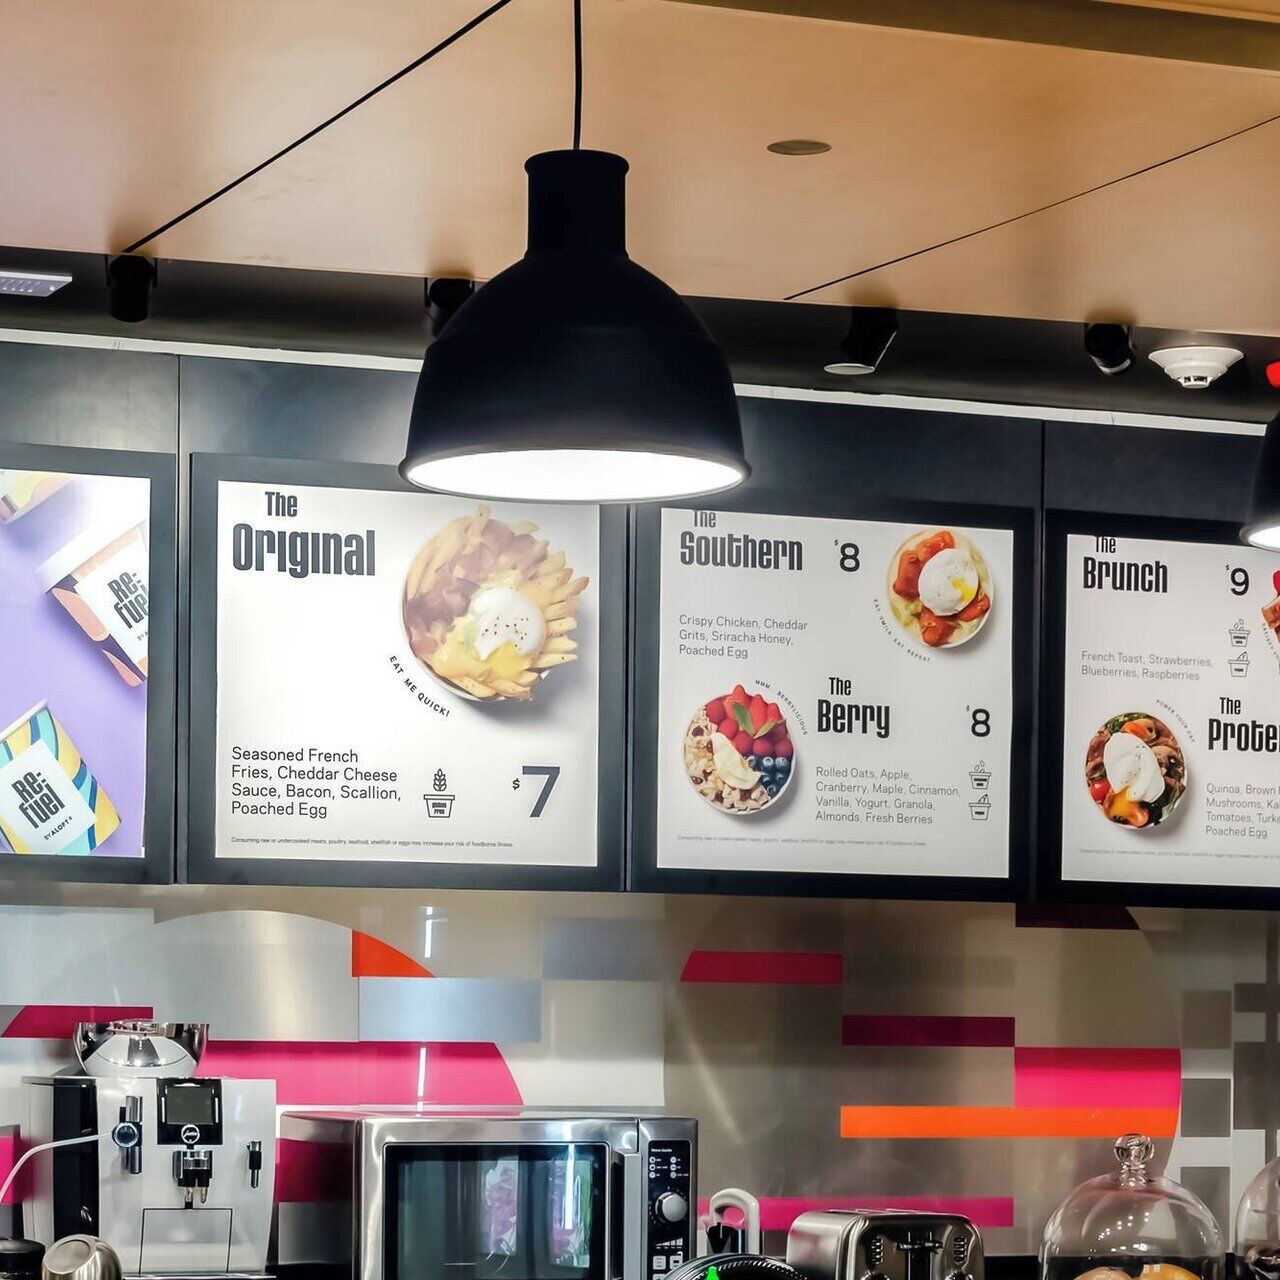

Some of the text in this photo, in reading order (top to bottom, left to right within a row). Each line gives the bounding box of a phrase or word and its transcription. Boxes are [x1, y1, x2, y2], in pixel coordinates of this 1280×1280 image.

[265, 491, 297, 517] The
[233, 523, 375, 578] Original
[681, 531, 802, 571] Southern
[1083, 557, 1167, 593] Brunch
[107, 571, 141, 604] Re:
[679, 614, 808, 630] Crispy Chicken, Cheddar
[679, 629, 793, 646] Grits, Sriracha Honey,
[679, 644, 748, 659] Poached Egg
[1081, 650, 1213, 667] French Toast, Strawberries,
[1081, 664, 1200, 681] Blueberries, Raspberries
[389, 655, 450, 717] EAT ME QUICK!
[829, 677, 851, 695] The
[1220, 697, 1241, 715] The
[818, 699, 890, 738] Berry
[232, 746, 358, 762] Seasoned French
[232, 765, 397, 782] Fries, Cheddar Cheese
[816, 766, 912, 781] Rolled Oats, Apple,
[11, 771, 47, 803] Re:
[232, 783, 401, 801] Sauce, Bacon, Scallion,
[816, 781, 869, 795] Cranberry,
[909, 784, 961, 798] Cinnamon,
[1207, 783, 1242, 797] Quinoa,
[1246, 784, 1276, 795] Brown
[19, 782, 65, 829] fuel
[232, 801, 327, 819] Poached Egg
[894, 798, 935, 812] Granola,
[1206, 796, 1263, 811] Mushrooms,
[815, 810, 932, 824] Almonds, Fresh Berries
[1206, 811, 1257, 824] Tomatoes,
[1206, 825, 1268, 839] Poached Egg
